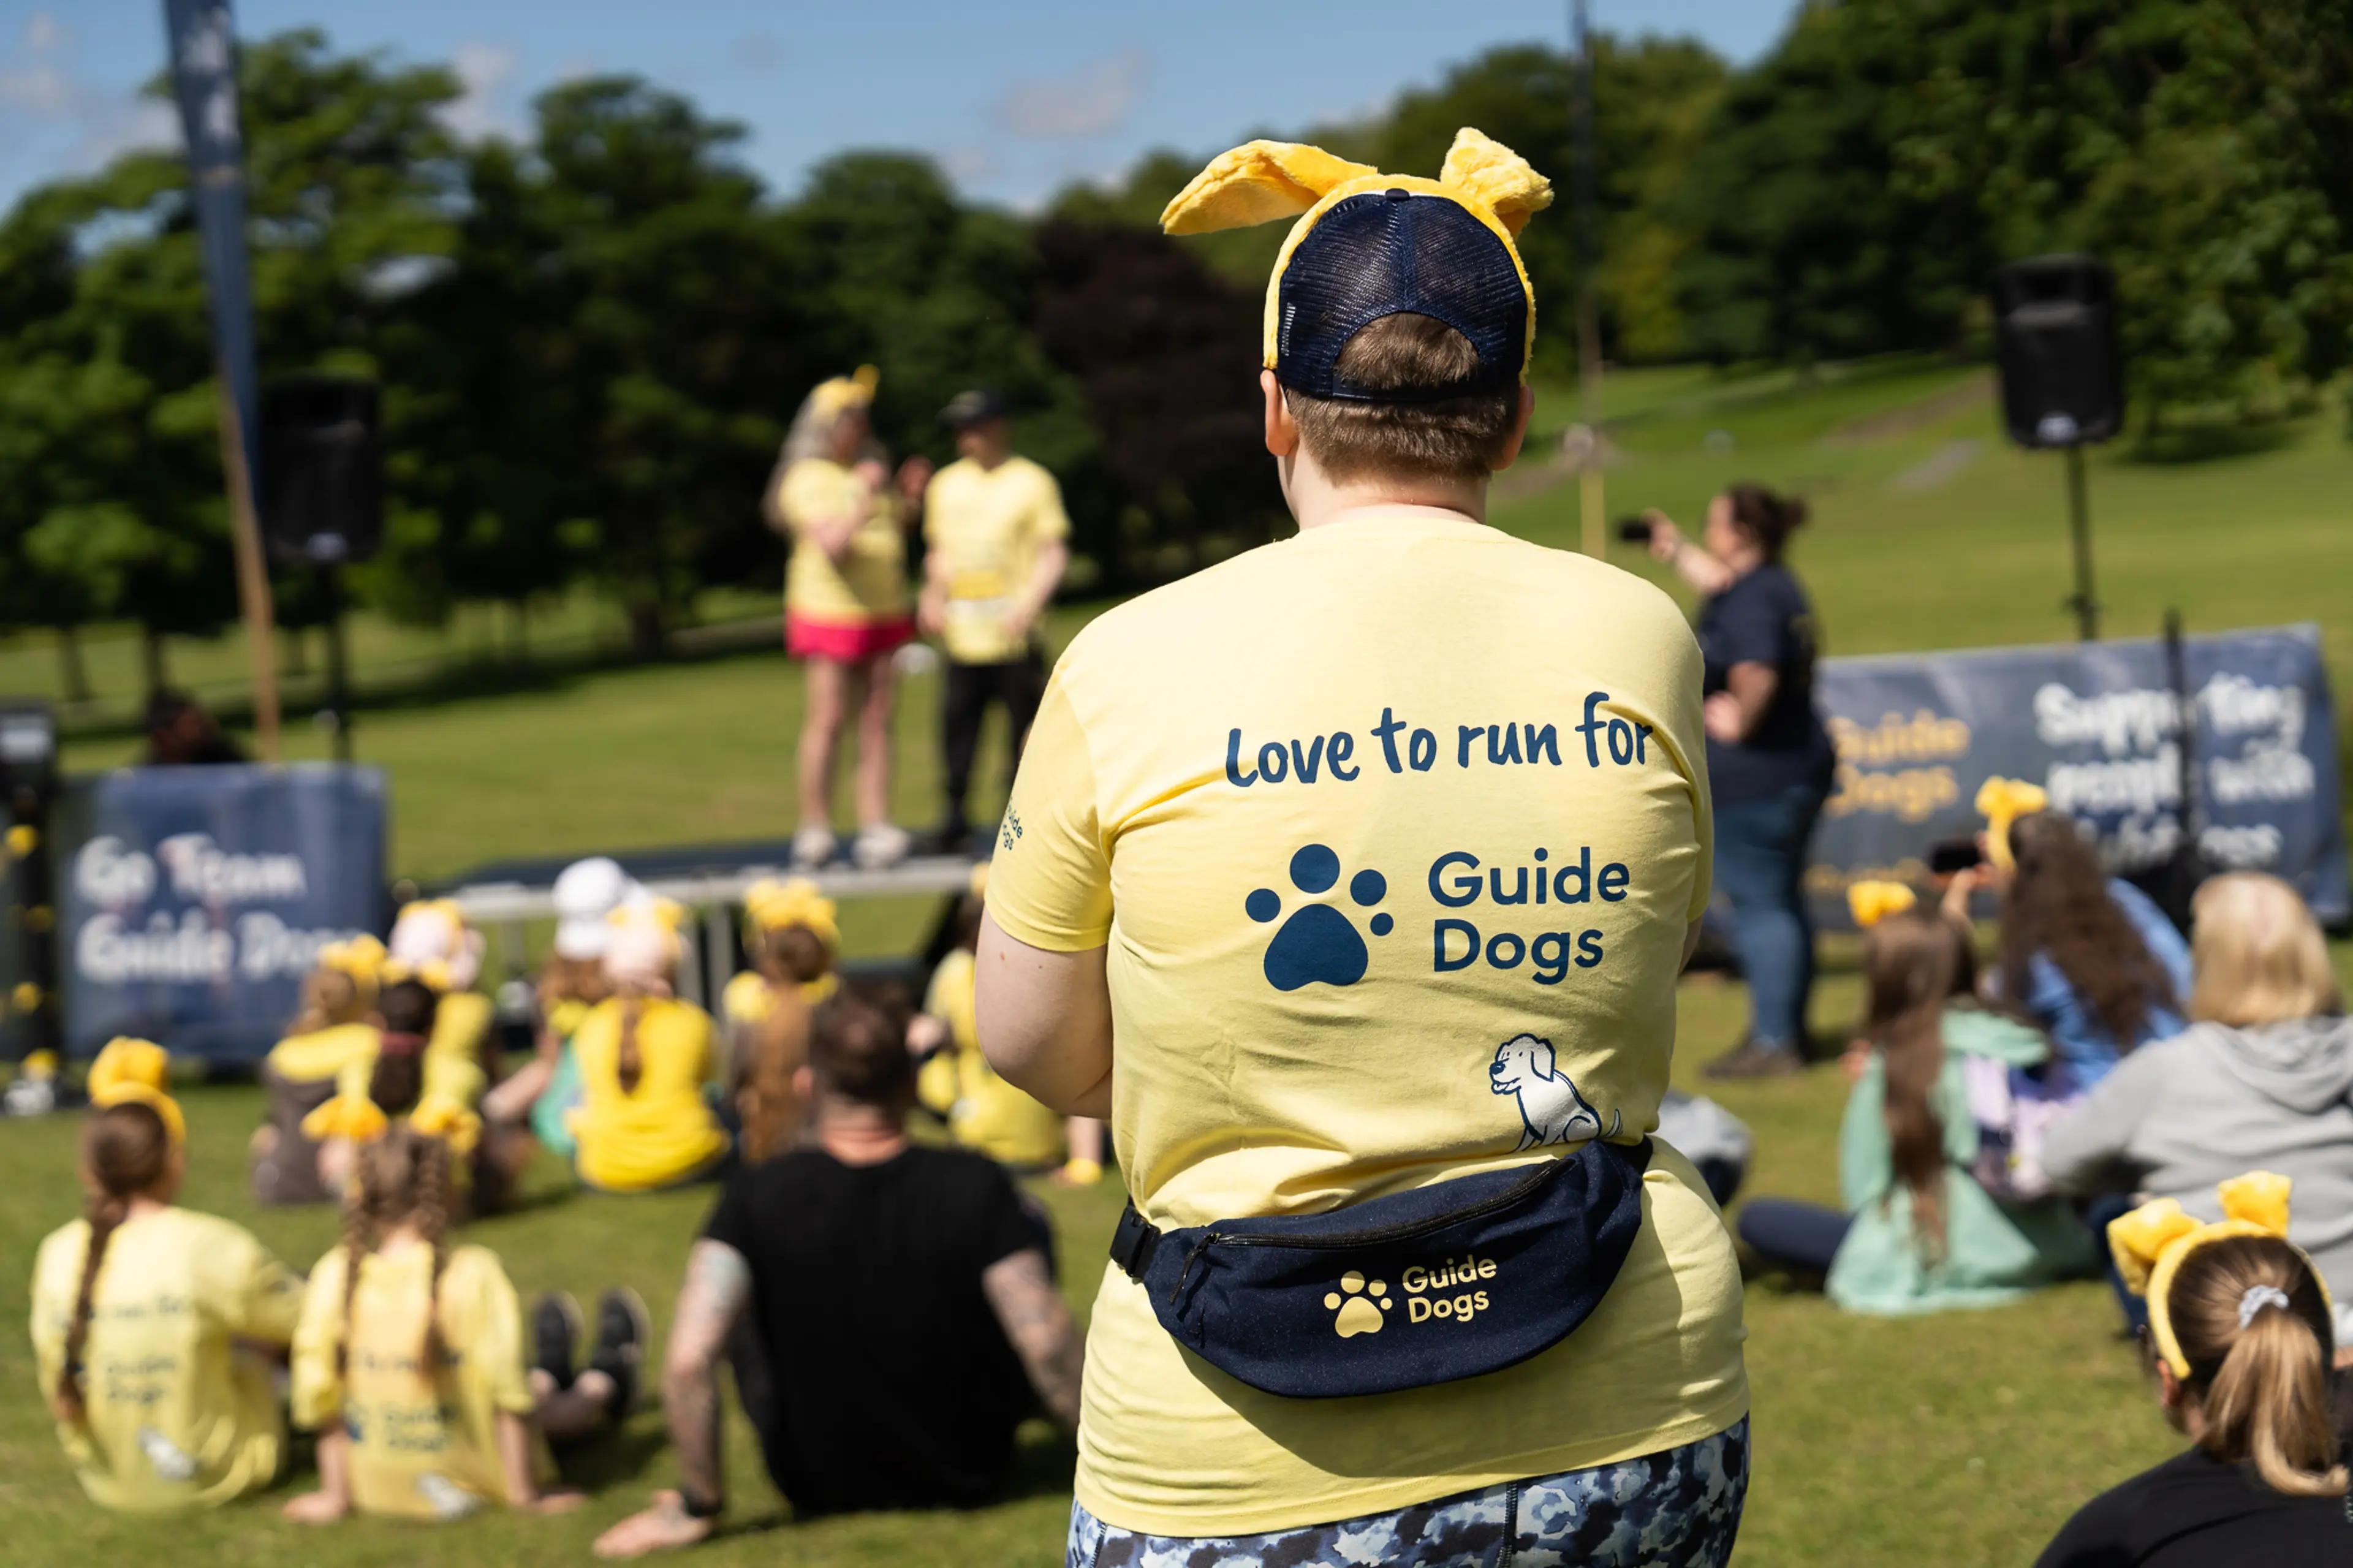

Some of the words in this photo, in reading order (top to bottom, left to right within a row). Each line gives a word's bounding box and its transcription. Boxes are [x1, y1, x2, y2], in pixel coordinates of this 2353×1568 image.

[1226, 728, 1360, 787] Love
[1370, 707, 1438, 773] to
[1458, 722, 1562, 768] run
[1575, 691, 1654, 768] for
[75, 835, 156, 905] Go
[1428, 846, 1630, 907] Guide
[1434, 918, 1604, 985] Dogs
[1402, 1254, 1497, 1293] Guide
[1408, 1290, 1490, 1324] Dogs
